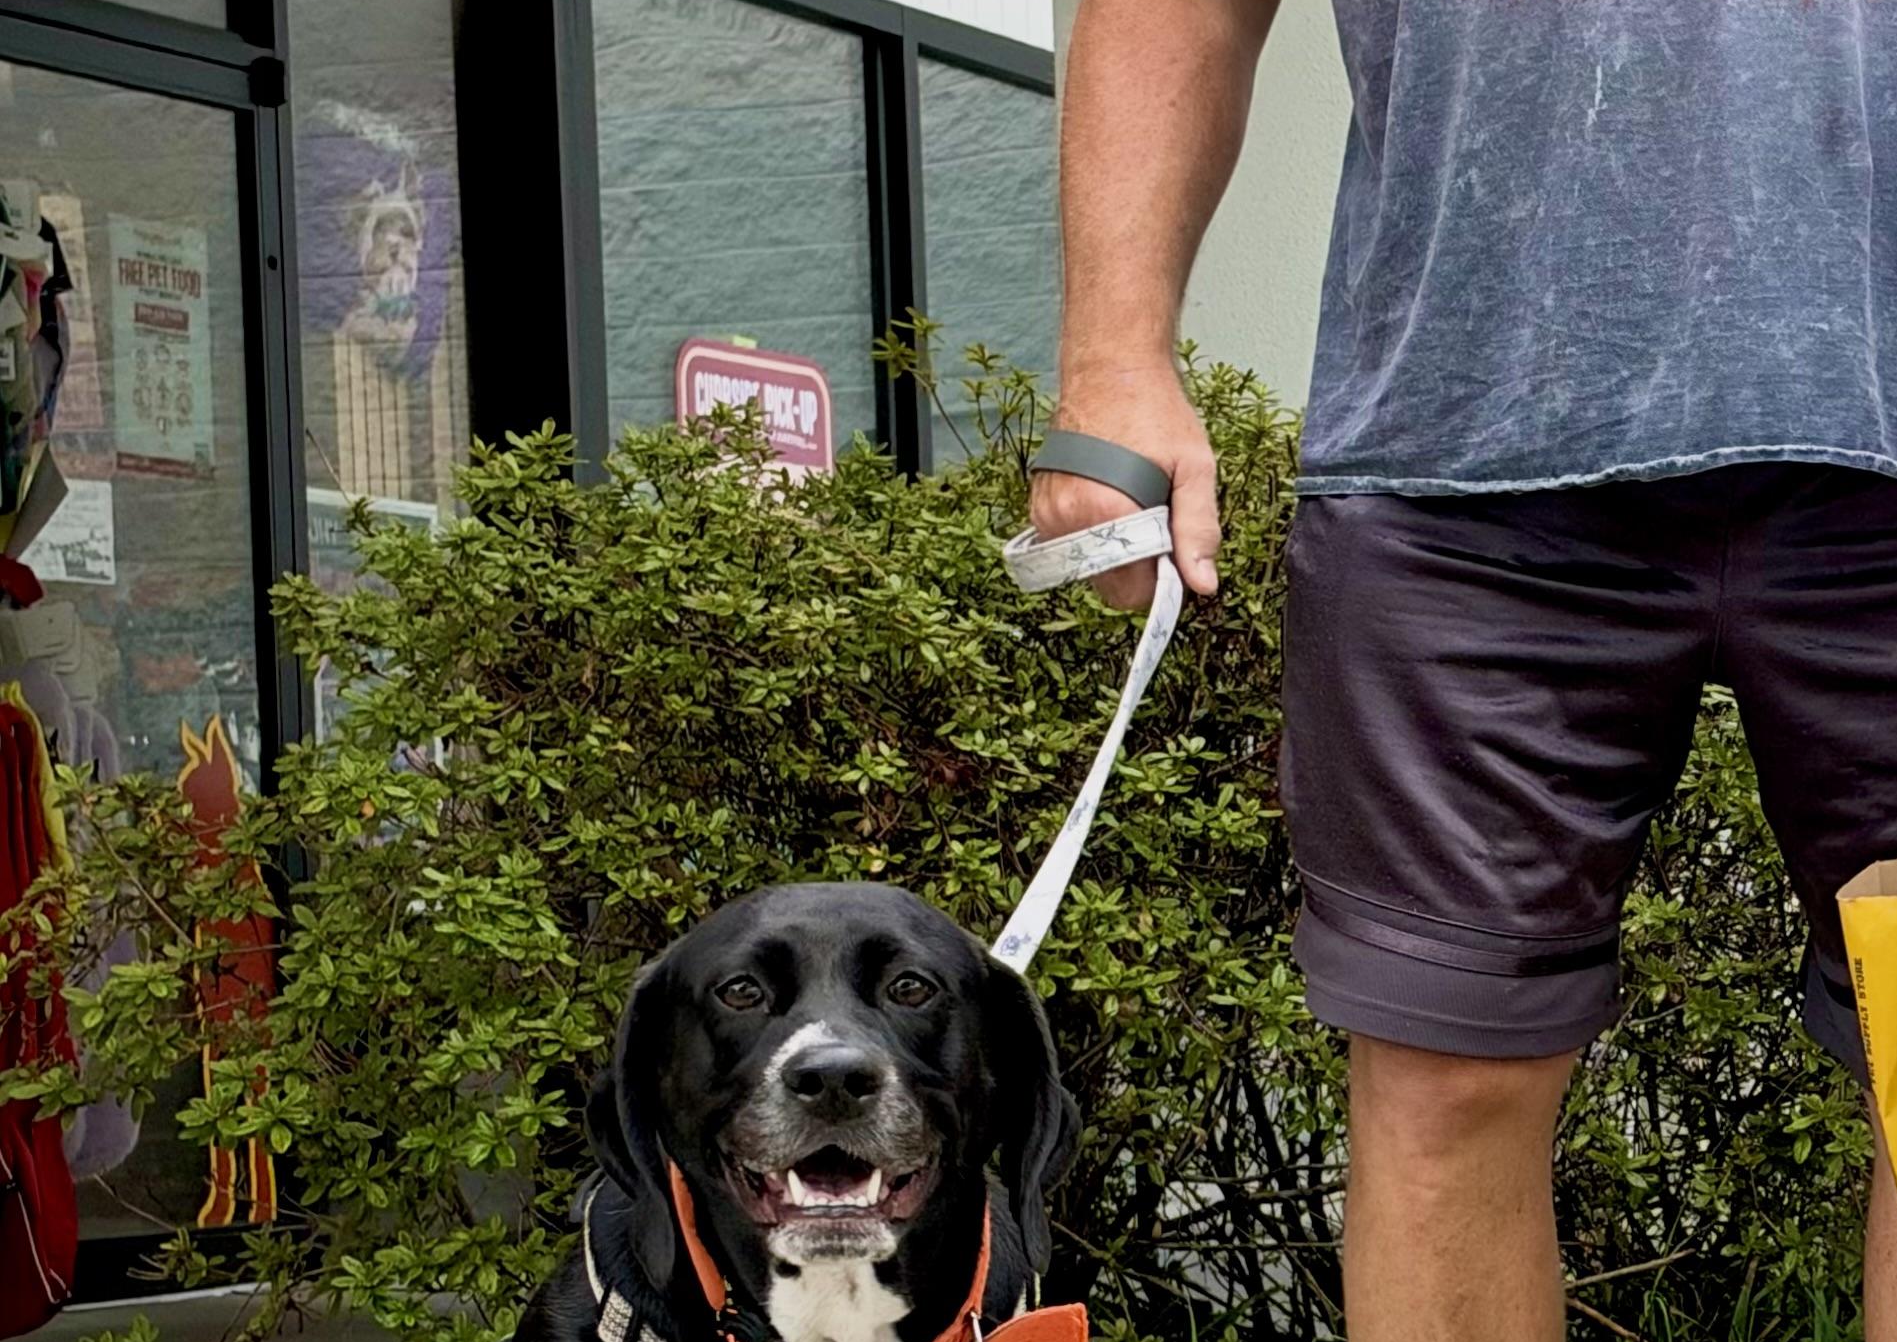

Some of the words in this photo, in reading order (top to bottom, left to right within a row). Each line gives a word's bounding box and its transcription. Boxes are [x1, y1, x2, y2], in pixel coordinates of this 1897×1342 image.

[117, 257, 144, 288] FREE
[146, 262, 168, 290] PET
[1854, 957, 1866, 1000] STORE
